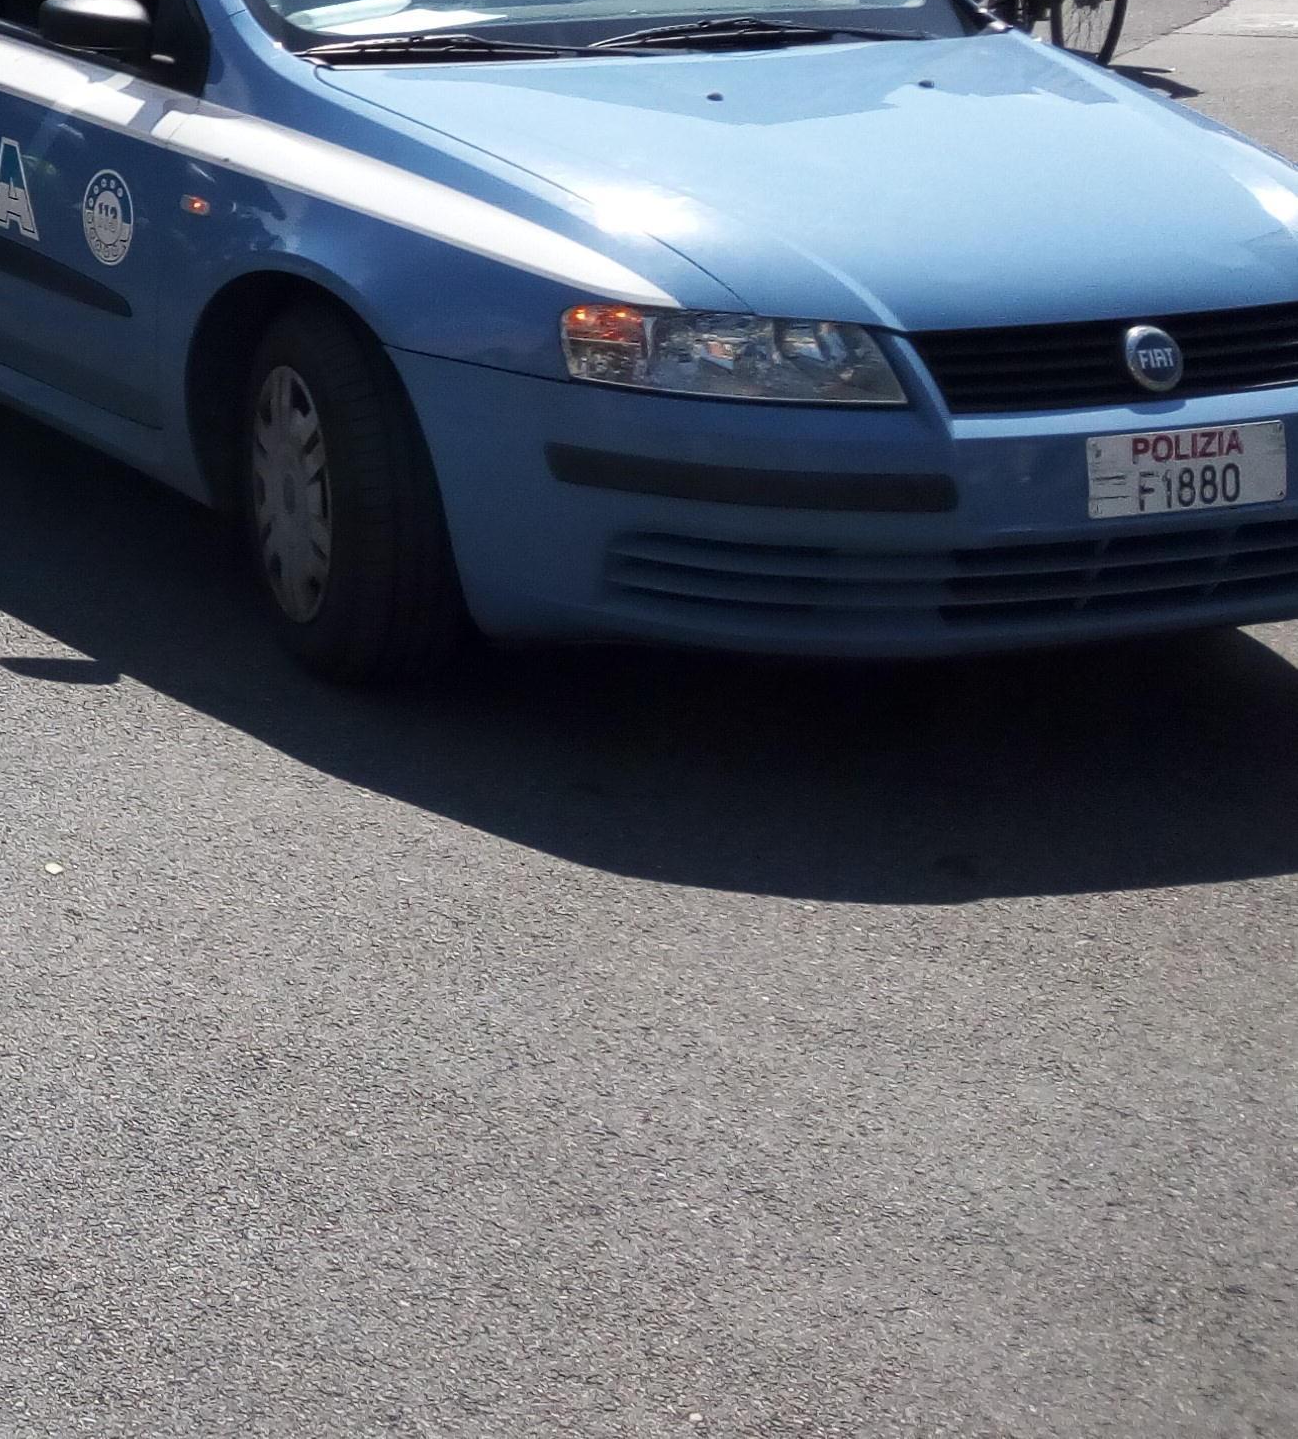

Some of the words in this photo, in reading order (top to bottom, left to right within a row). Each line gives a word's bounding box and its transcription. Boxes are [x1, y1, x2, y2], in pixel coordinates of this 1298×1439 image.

[1137, 347, 1174, 369] FIAT
[1132, 429, 1244, 464] POLIZIA
[1138, 462, 1241, 511] F1880
